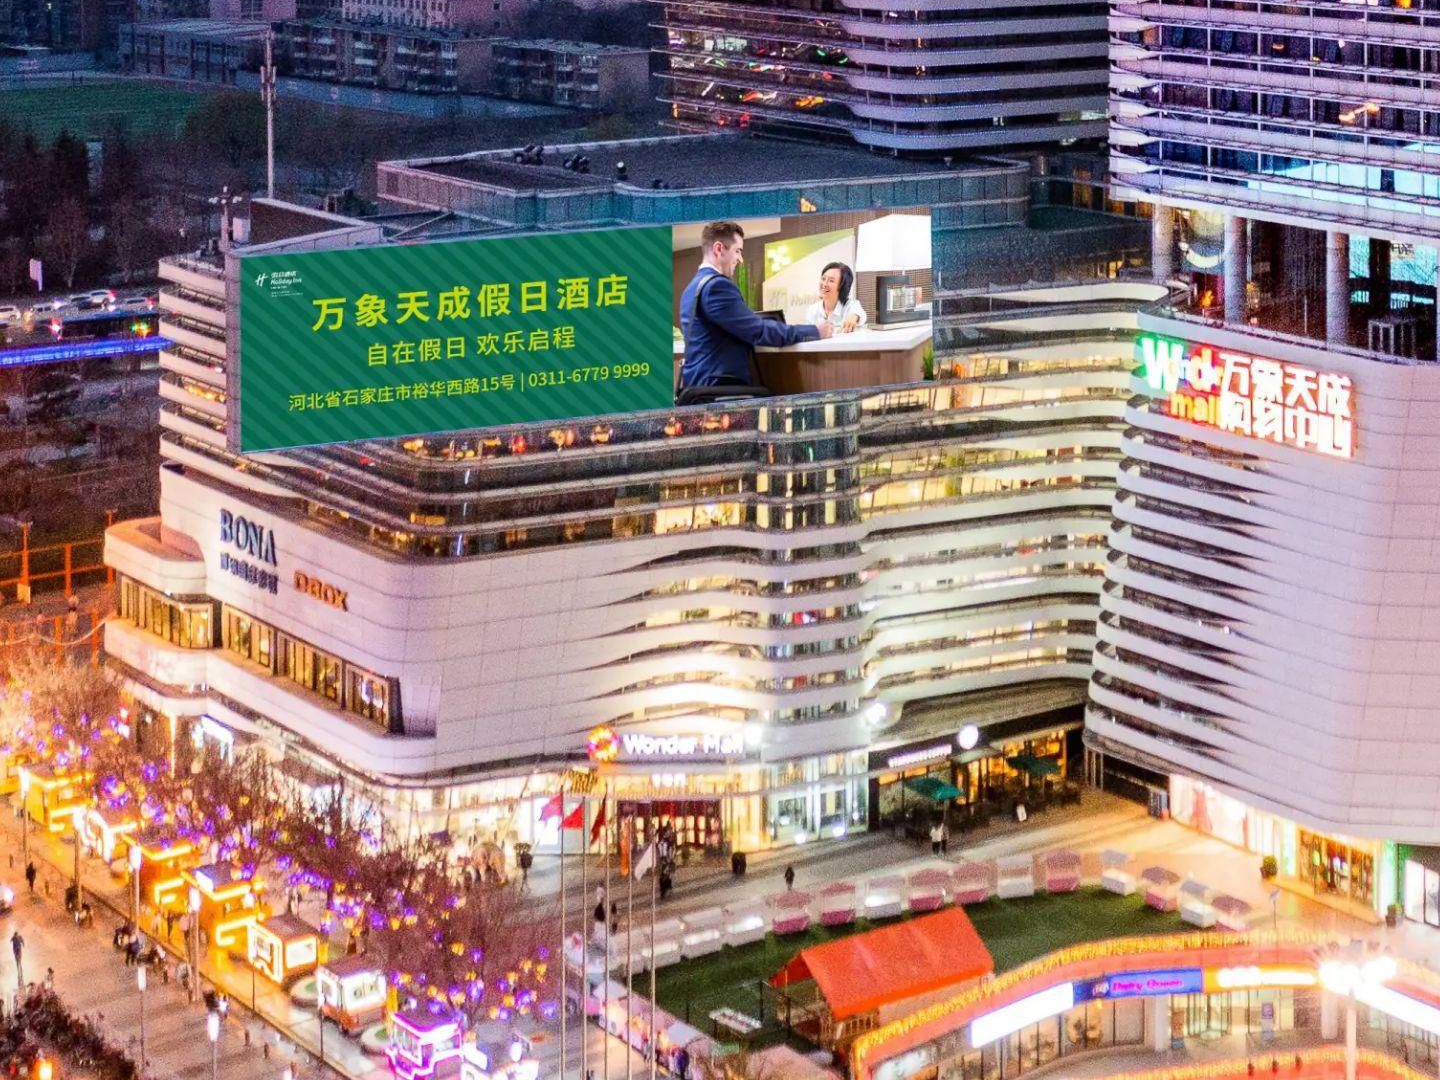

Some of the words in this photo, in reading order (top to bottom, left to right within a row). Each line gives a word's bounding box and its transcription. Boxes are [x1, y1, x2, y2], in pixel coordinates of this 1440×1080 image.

[312, 273, 629, 332] 万象天成假日酒店
[367, 333, 467, 367] 自在假日
[476, 324, 576, 356] 欢乐启程
[288, 374, 515, 412] 河北省石家庄市裕华西路15号
[528, 366, 609, 388] 0311-6779
[612, 362, 650, 380] 9999
[1219, 352, 1352, 418] 万象天成
[220, 508, 277, 567] BONA
[622, 733, 698, 755] Wonder
[703, 731, 744, 754] Mall
